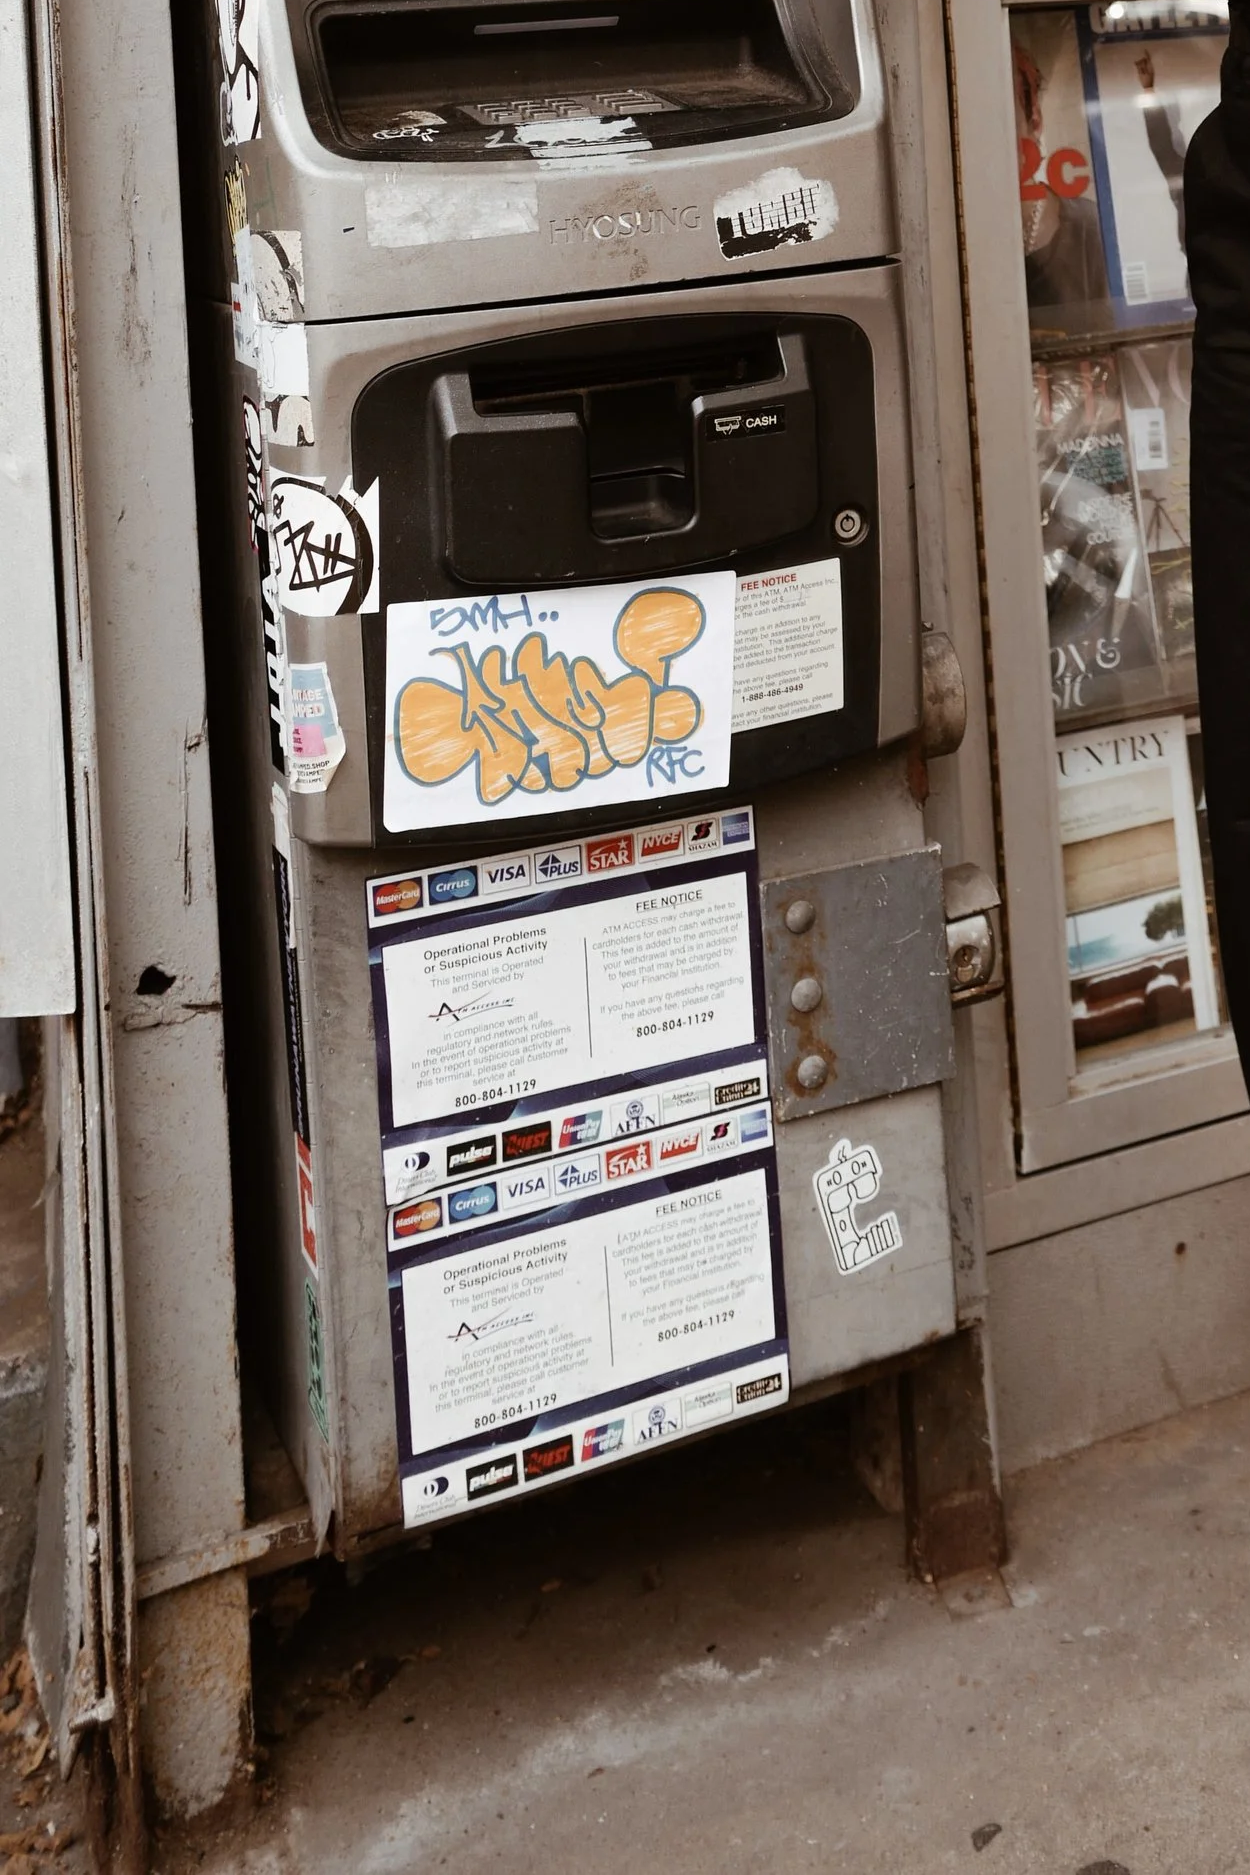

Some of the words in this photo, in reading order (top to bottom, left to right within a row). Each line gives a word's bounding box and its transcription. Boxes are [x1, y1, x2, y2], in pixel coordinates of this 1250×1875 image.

[549, 205, 701, 245] HYOSUNG
[745, 415, 777, 428] CASH
[741, 581, 758, 591] FEE
[761, 574, 796, 587] NOTICE
[1095, 636, 1121, 668] &
[742, 684, 803, 702] 1-888-486-4949
[1057, 730, 1169, 777] UNTRY
[376, 887, 420, 905] MasterCard
[435, 878, 470, 893] Cirrus
[486, 864, 526, 884] VISA
[549, 860, 579, 877] PLUS
[590, 849, 630, 871] STAR
[643, 834, 679, 850] NYCE
[688, 841, 718, 853] SHAZAM
[636, 899, 657, 911] FEE
[661, 891, 702, 906] NOTICE
[423, 939, 488, 961] Operational
[493, 928, 546, 945] Problems
[424, 964, 435, 974] or
[439, 950, 502, 971] Suspicious
[506, 941, 547, 957] Activity
[431, 977, 449, 988] This
[452, 969, 488, 983] terminal
[501, 958, 543, 972] Operated
[452, 984, 468, 993] and
[471, 975, 510, 989] Serviced
[513, 972, 523, 981] by
[443, 1030, 450, 1040] in
[453, 1020, 504, 1039] compliance
[507, 1016, 525, 1026] with
[528, 1013, 538, 1021] all
[636, 1012, 714, 1036] 800-804-1129
[426, 1039, 470, 1056] regulatory
[474, 1034, 490, 1043] and
[493, 1026, 528, 1039] network
[416, 1078, 432, 1088] this
[435, 1070, 474, 1084] terminal,
[477, 1062, 506, 1075] please
[509, 1058, 523, 1067] call
[527, 1050, 567, 1062] customer
[455, 1079, 537, 1108] 800-804-1129
[449, 1145, 493, 1169] pulse
[395, 1208, 442, 1229] MasterCard
[455, 1194, 489, 1210] Cirrus
[508, 1177, 545, 1197] VISA
[569, 1167, 598, 1185] PLUS
[608, 1155, 649, 1178] STAR
[661, 1133, 698, 1153] NYCE
[655, 1203, 676, 1215] FEE
[680, 1191, 721, 1209] NOTICE
[443, 1255, 509, 1281] Operational
[513, 1241, 566, 1259] Problems
[443, 1284, 454, 1294] or
[458, 1266, 522, 1289] Suspicious
[526, 1253, 567, 1271] Activity
[658, 1311, 734, 1340] 800-804-1129
[474, 1395, 557, 1427] 800-804-1129
